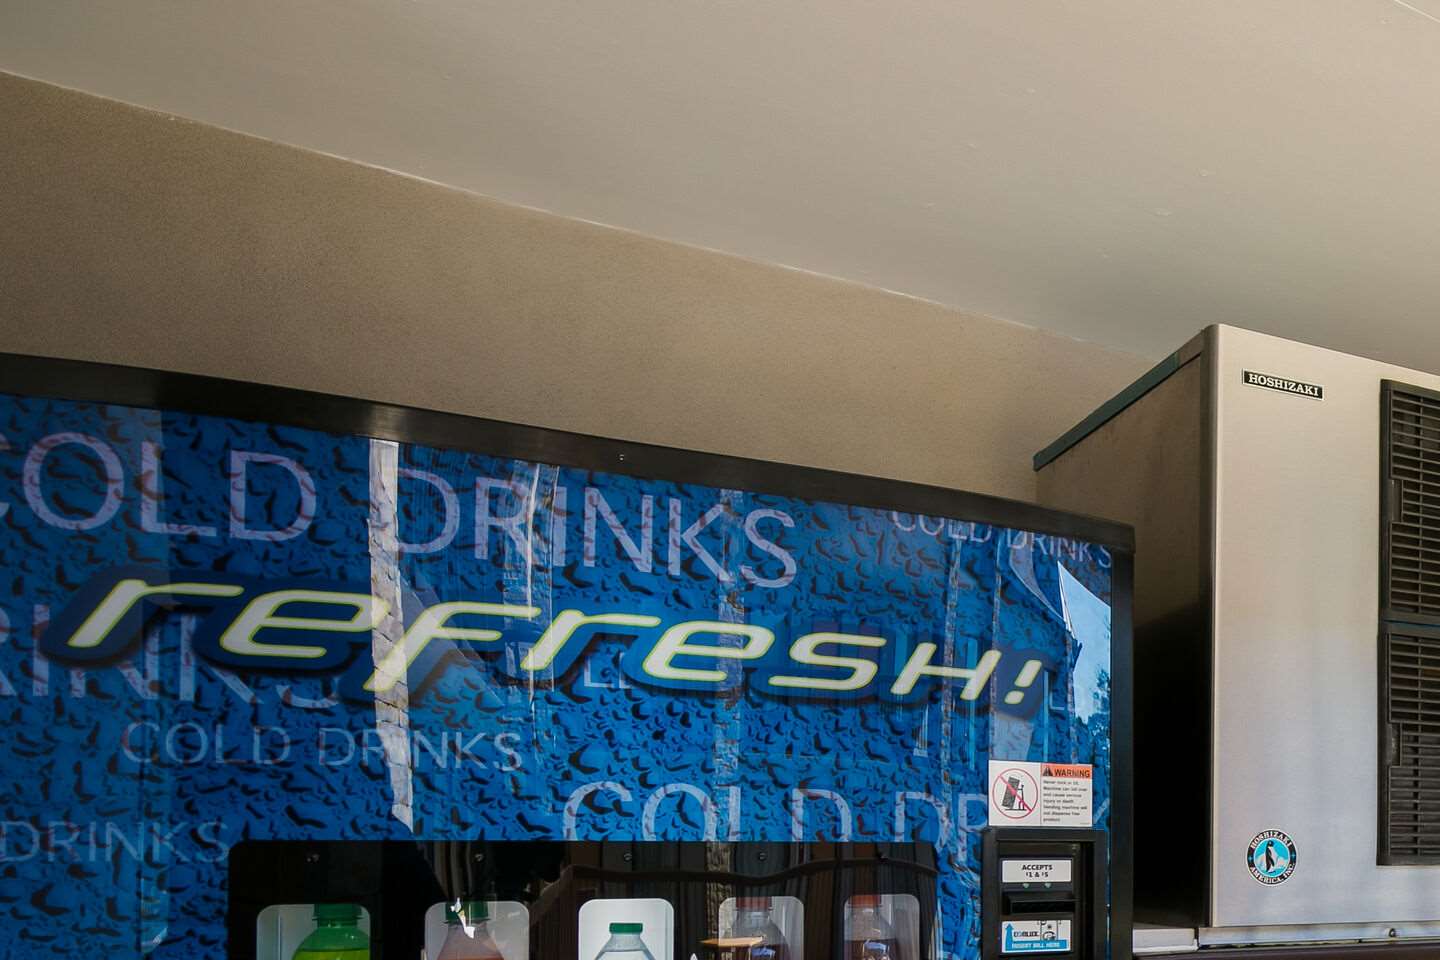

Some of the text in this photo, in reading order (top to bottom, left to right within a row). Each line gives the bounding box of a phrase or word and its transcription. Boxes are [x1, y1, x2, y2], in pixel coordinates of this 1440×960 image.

[1248, 373, 1319, 396] HOSHIZAKI
[0, 430, 317, 542] OLD
[121, 722, 522, 772] COLD DRNKS
[1054, 767, 1091, 778] WARNING
[1250, 830, 1293, 849] HOSHIZAKI
